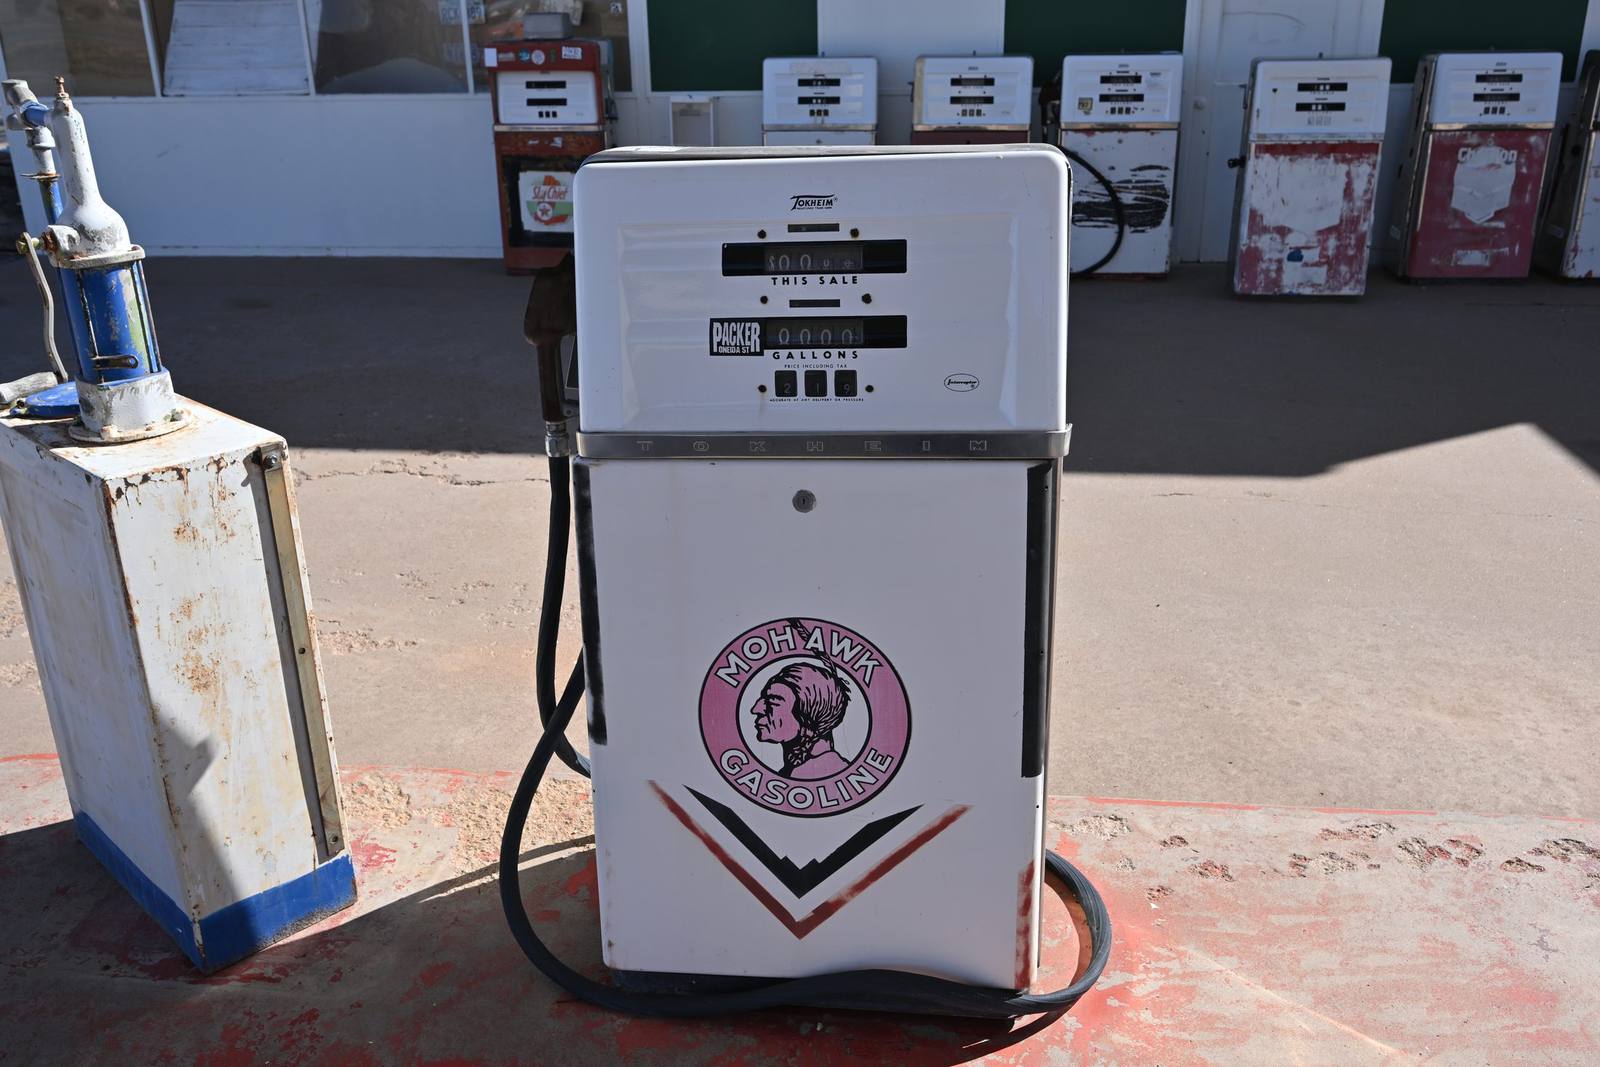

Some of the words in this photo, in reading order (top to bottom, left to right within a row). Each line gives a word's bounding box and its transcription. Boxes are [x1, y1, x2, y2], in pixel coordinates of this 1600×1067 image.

[532, 185, 547, 201] Sky
[547, 185, 568, 201] Chief
[790, 194, 836, 211] TOKHEIM
[771, 276, 808, 286] THIS
[819, 275, 859, 285] SALE
[712, 321, 761, 353] PACKER
[718, 345, 741, 354] ONEIDA
[741, 345, 750, 354] ST
[772, 350, 859, 360] GALLONS
[715, 624, 883, 689] MOHAWK
[719, 747, 894, 809] GASOLINE
